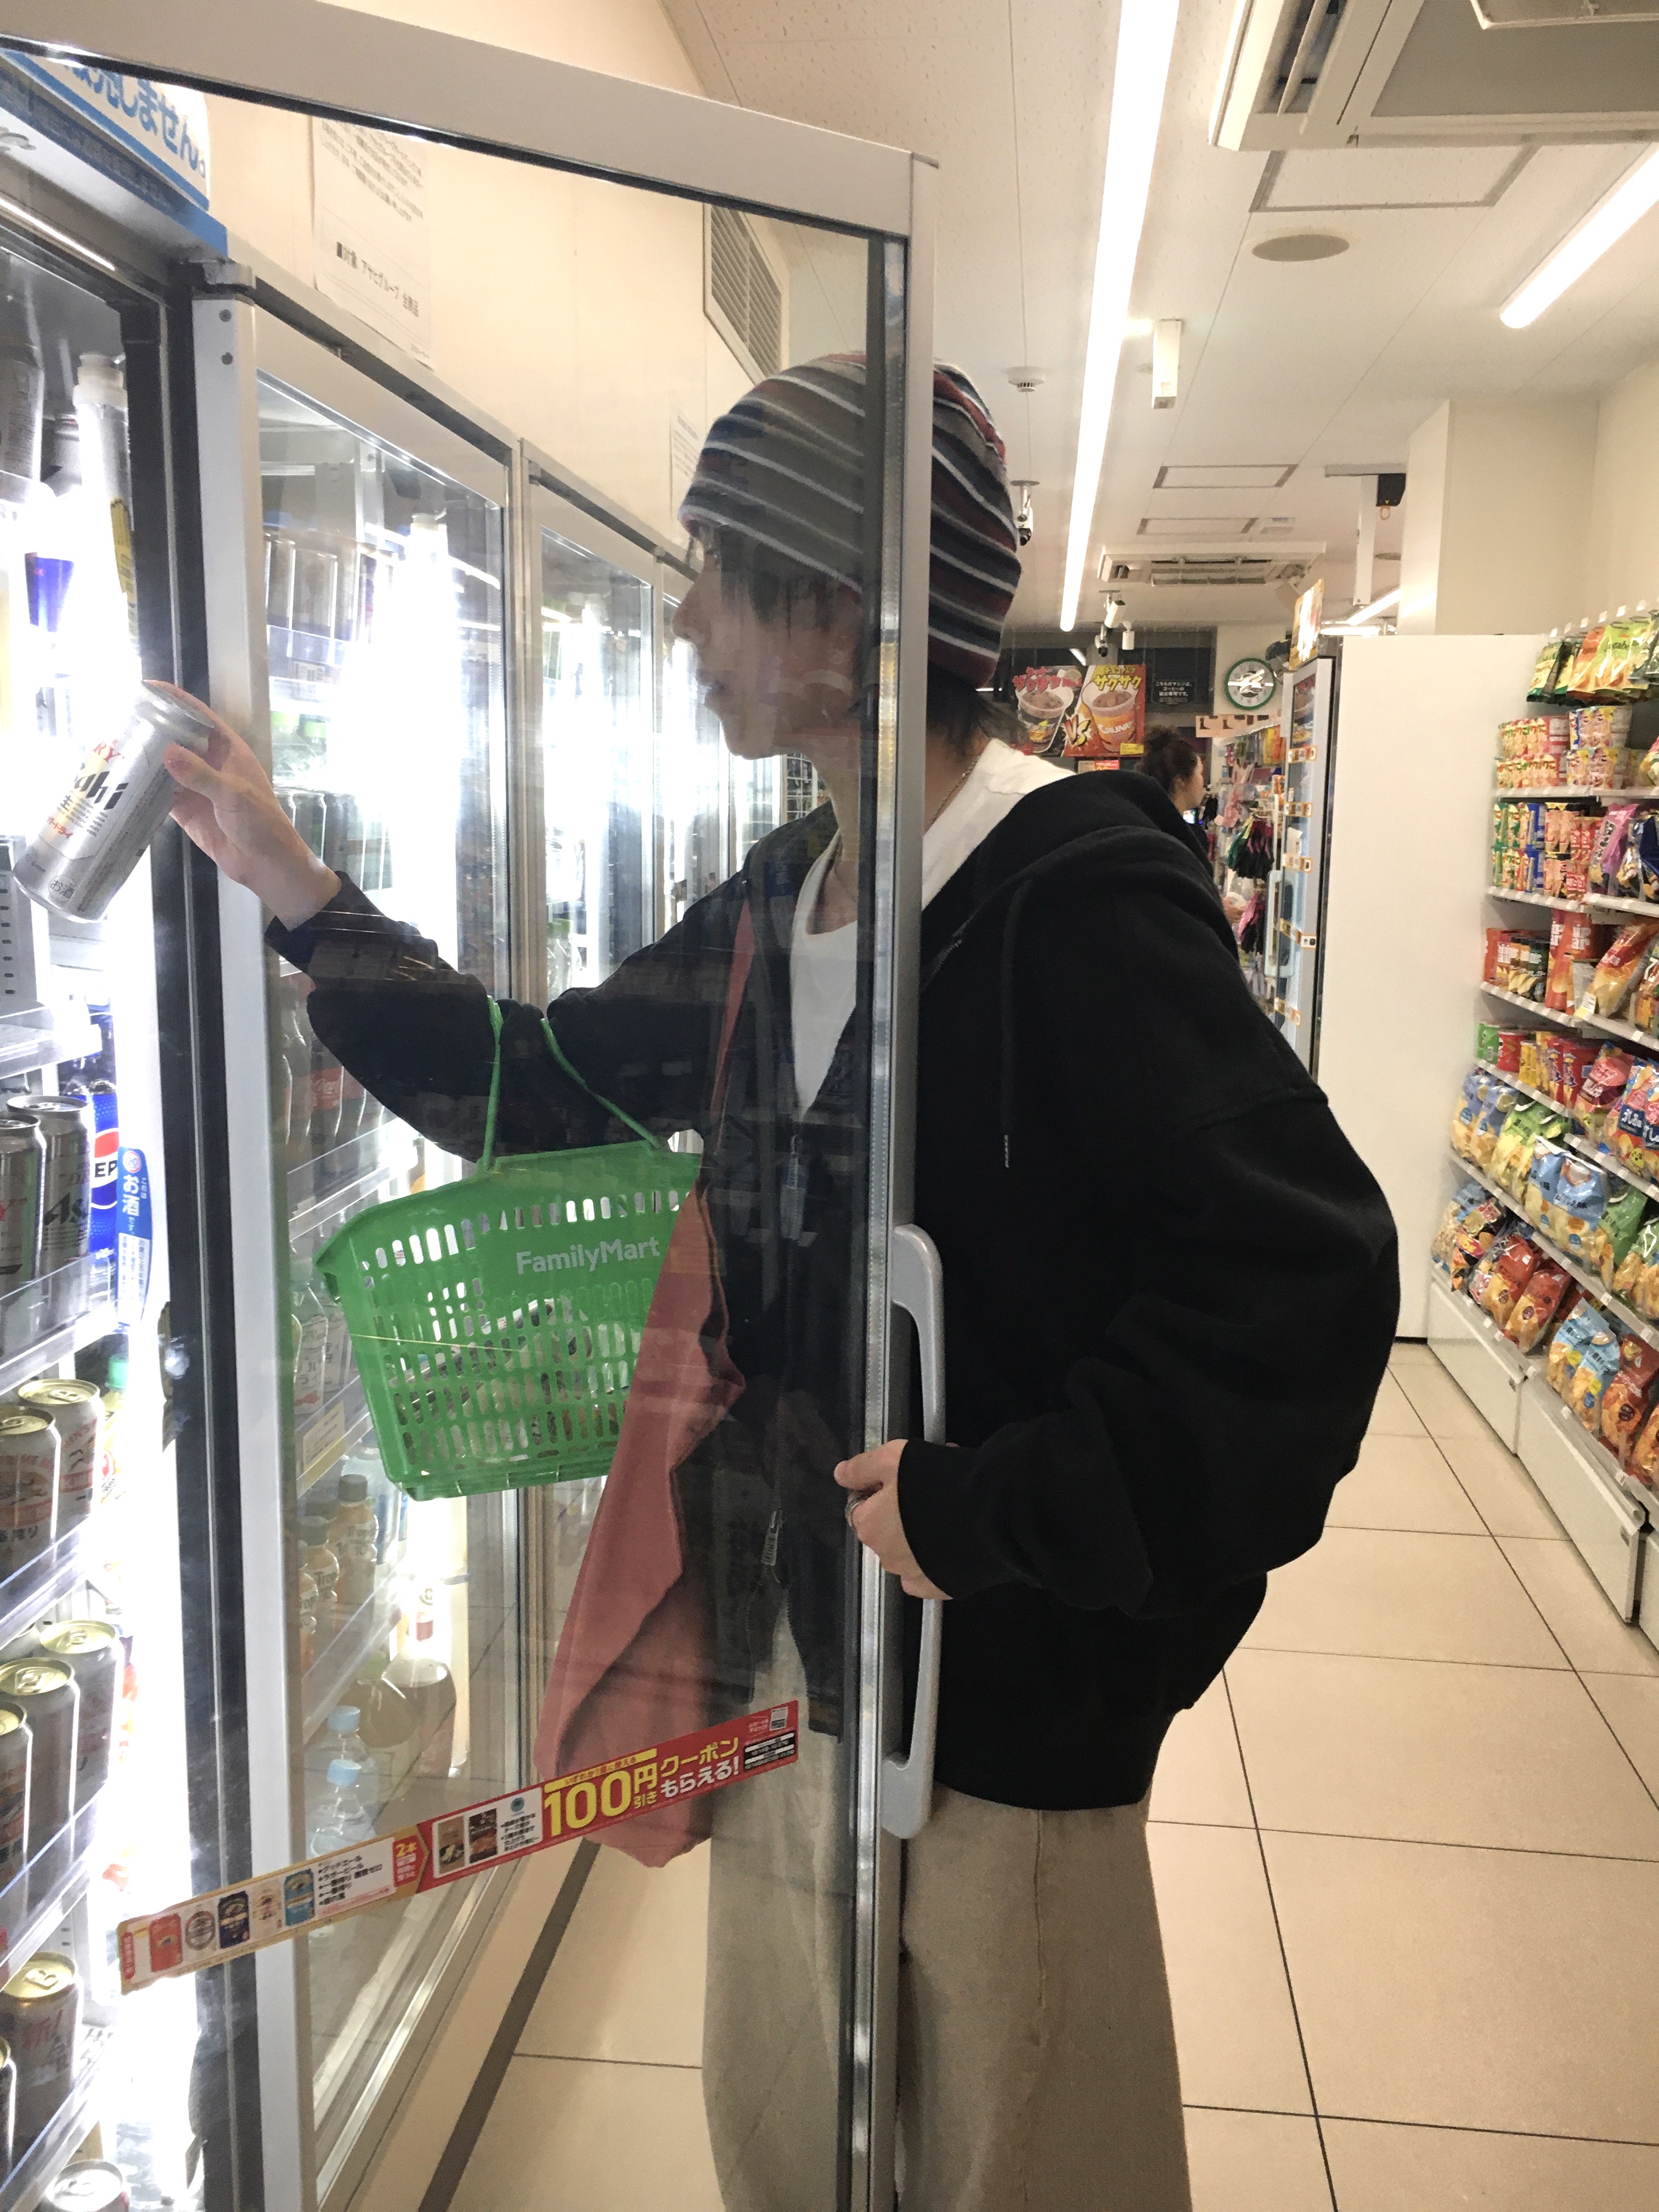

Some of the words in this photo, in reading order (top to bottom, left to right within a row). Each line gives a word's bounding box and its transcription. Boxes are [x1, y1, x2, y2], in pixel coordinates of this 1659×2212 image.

[1094, 674, 1143, 691] サクサク
[1064, 714, 1091, 747] VS
[50, 879, 76, 899] お酒
[516, 1236, 661, 1275] FamilyMart
[660, 1737, 739, 1778] クーポン
[660, 1756, 740, 1799] もらえる!
[634, 1791, 658, 1809] 引き
